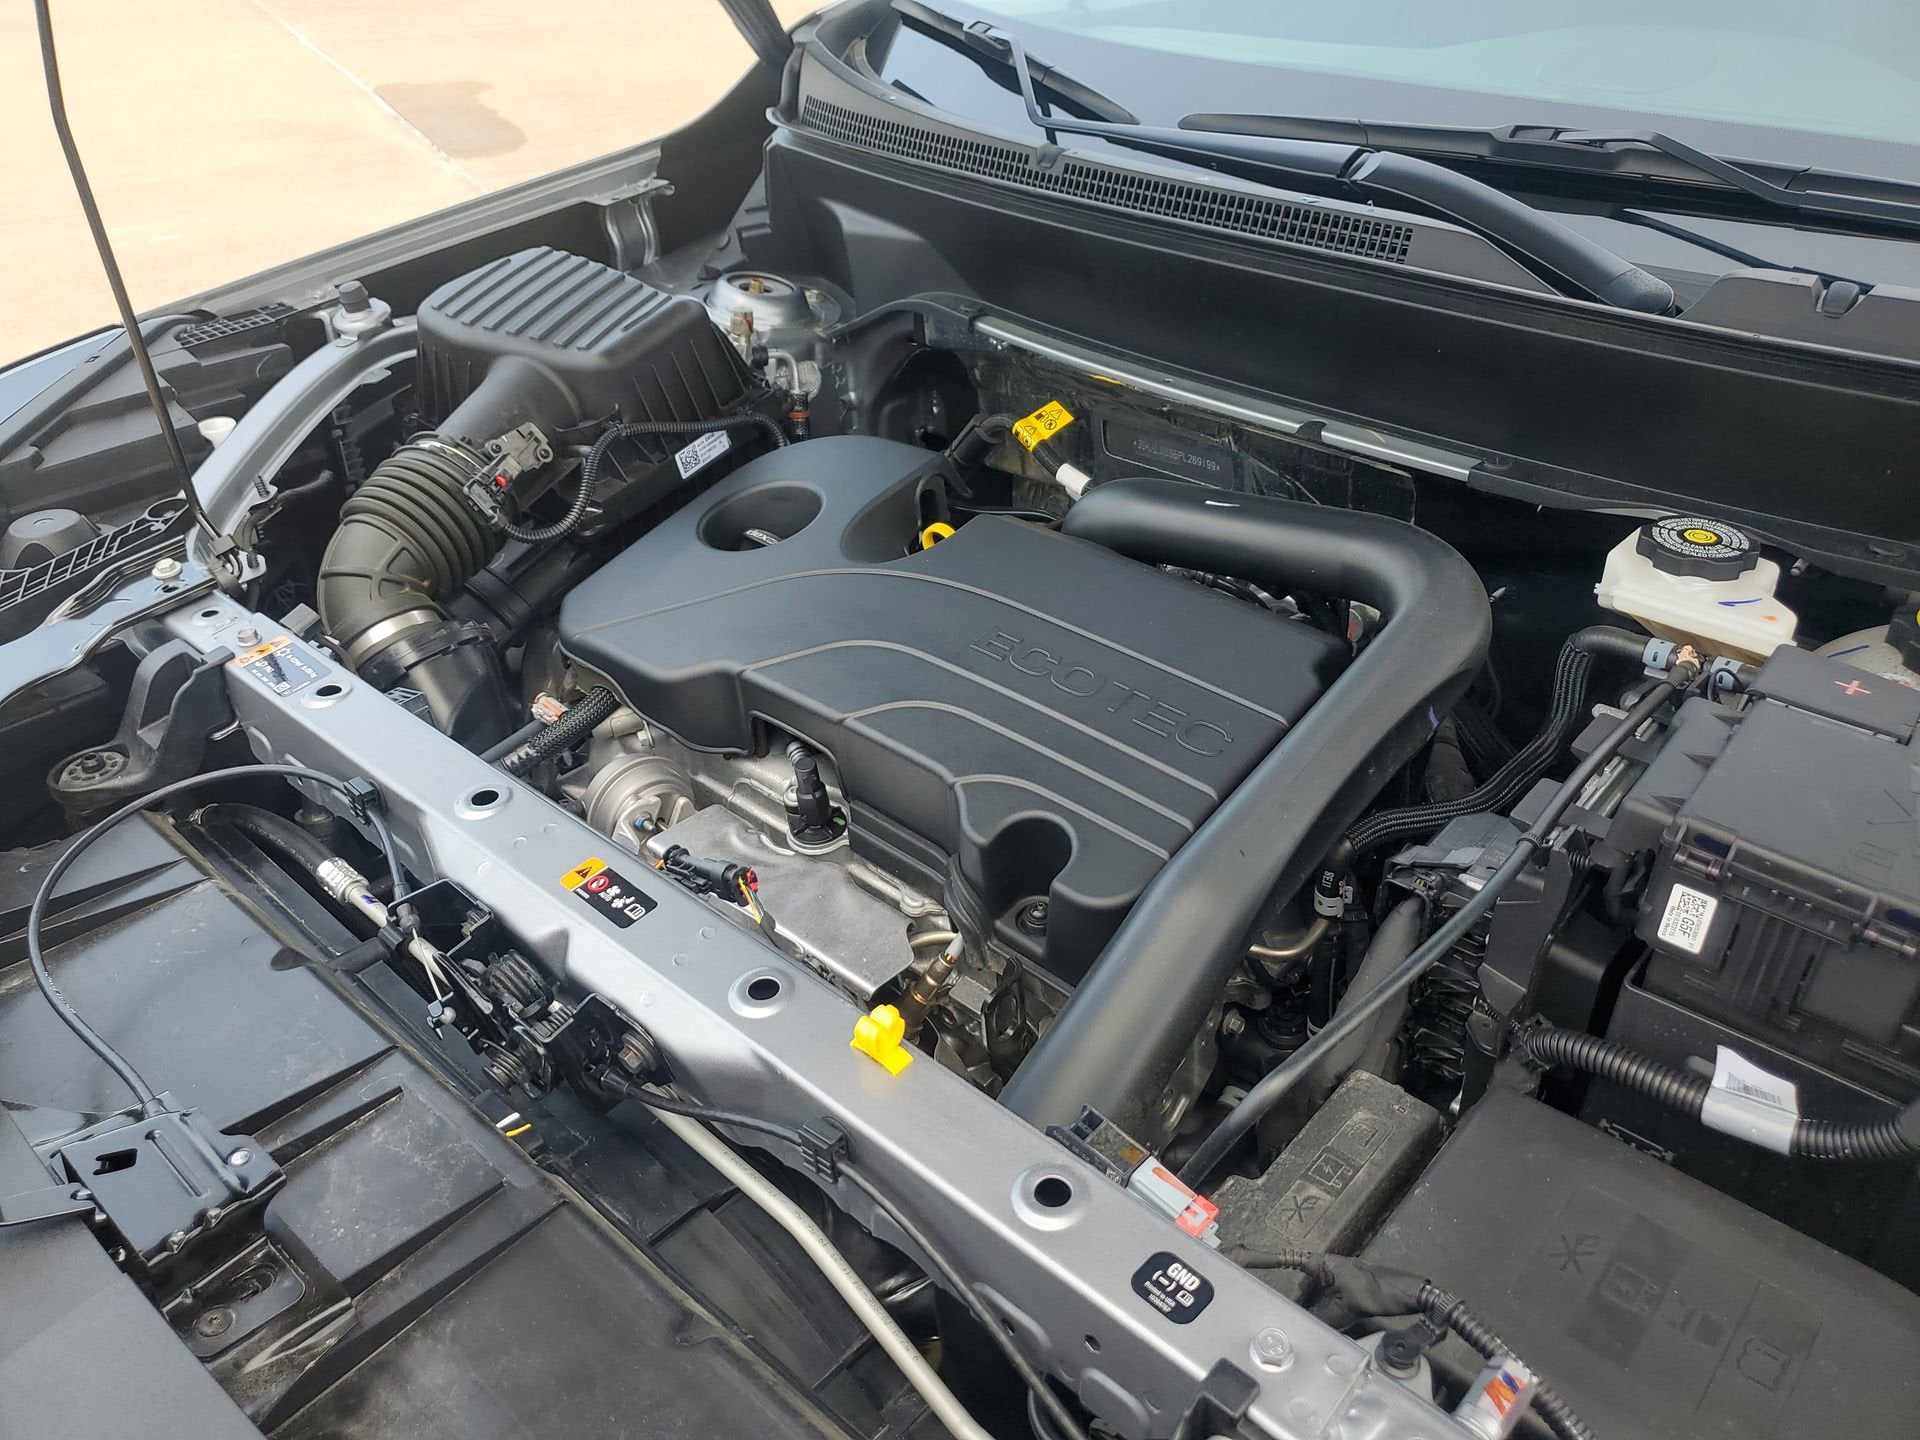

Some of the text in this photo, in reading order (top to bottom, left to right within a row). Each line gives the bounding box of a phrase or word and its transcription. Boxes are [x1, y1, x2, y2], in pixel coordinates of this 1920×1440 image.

[968, 631, 1233, 757] ECOTEC
[1679, 917, 1695, 938] G5F
[1166, 1263, 1200, 1291] GND
